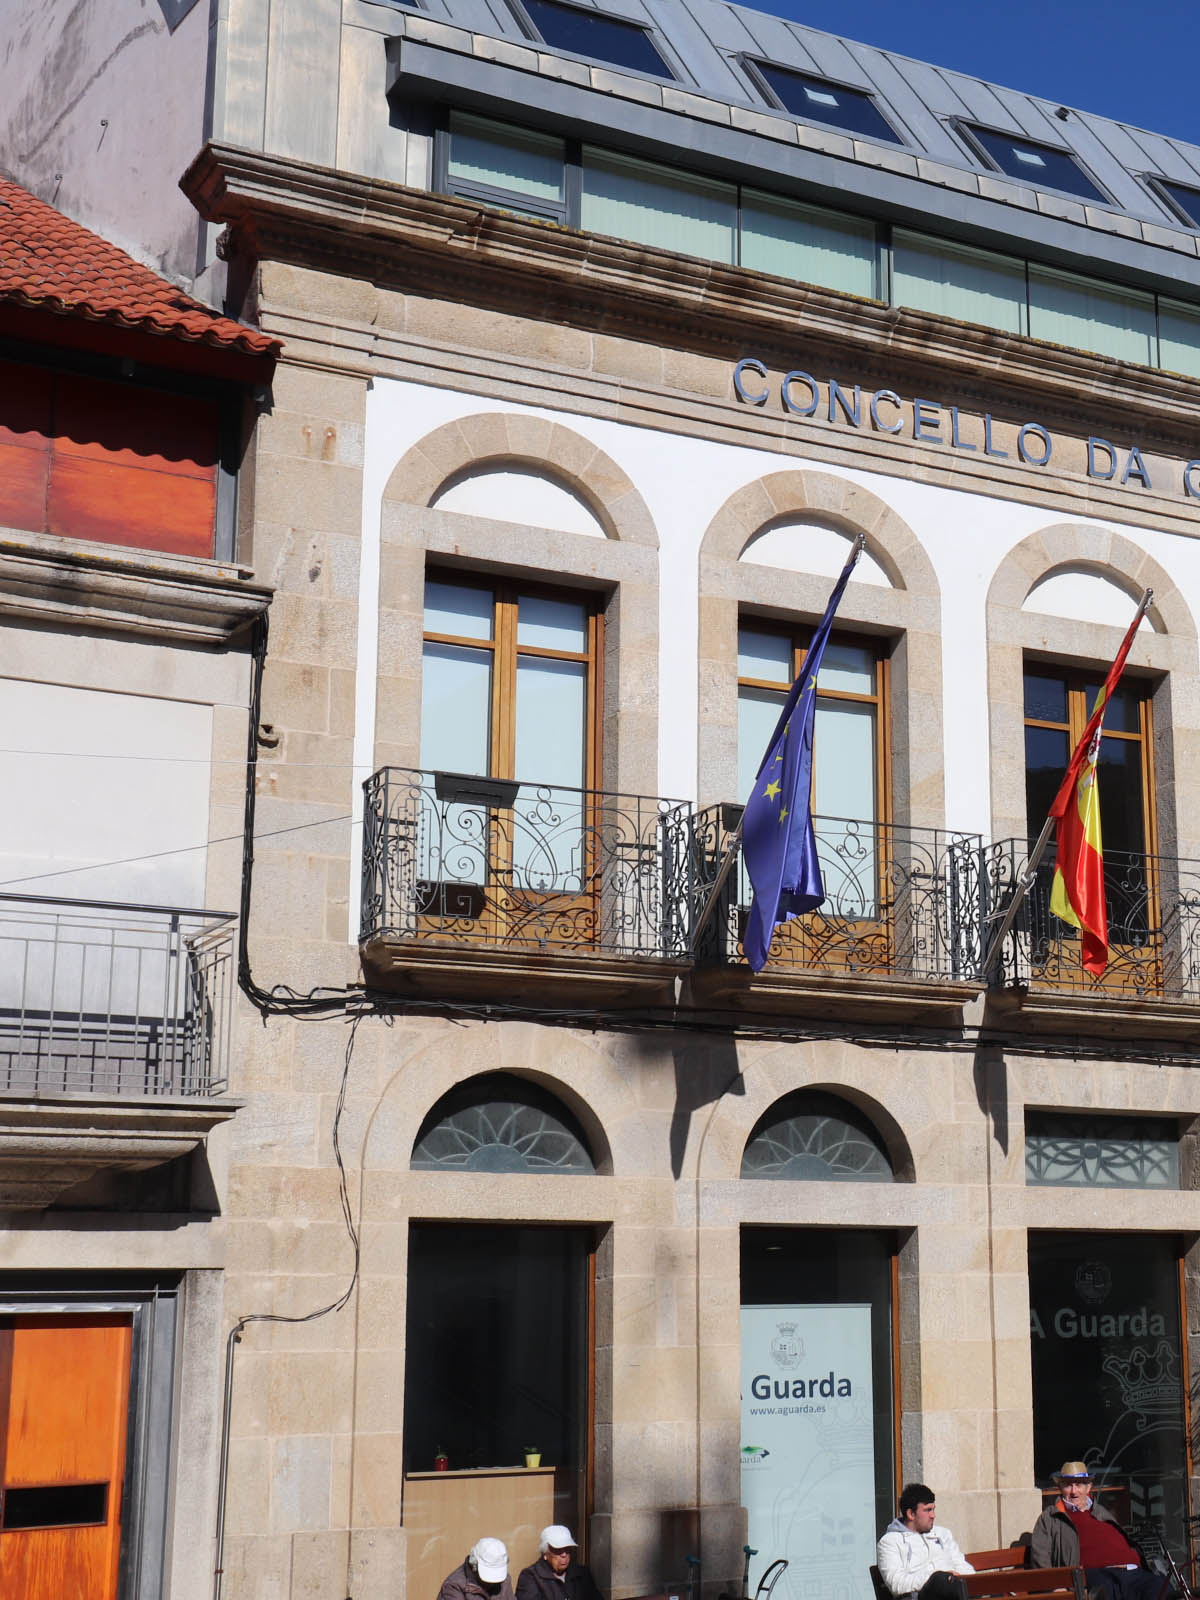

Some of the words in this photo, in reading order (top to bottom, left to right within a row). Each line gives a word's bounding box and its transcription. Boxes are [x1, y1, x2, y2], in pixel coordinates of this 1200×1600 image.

[734, 357, 1052, 466] CONCELLO
[1087, 436, 1152, 489] DA
[1054, 1306, 1166, 1338] Guarda
[751, 1371, 852, 1400] Guarda
[750, 1404, 826, 1416] www.aguarda.es
